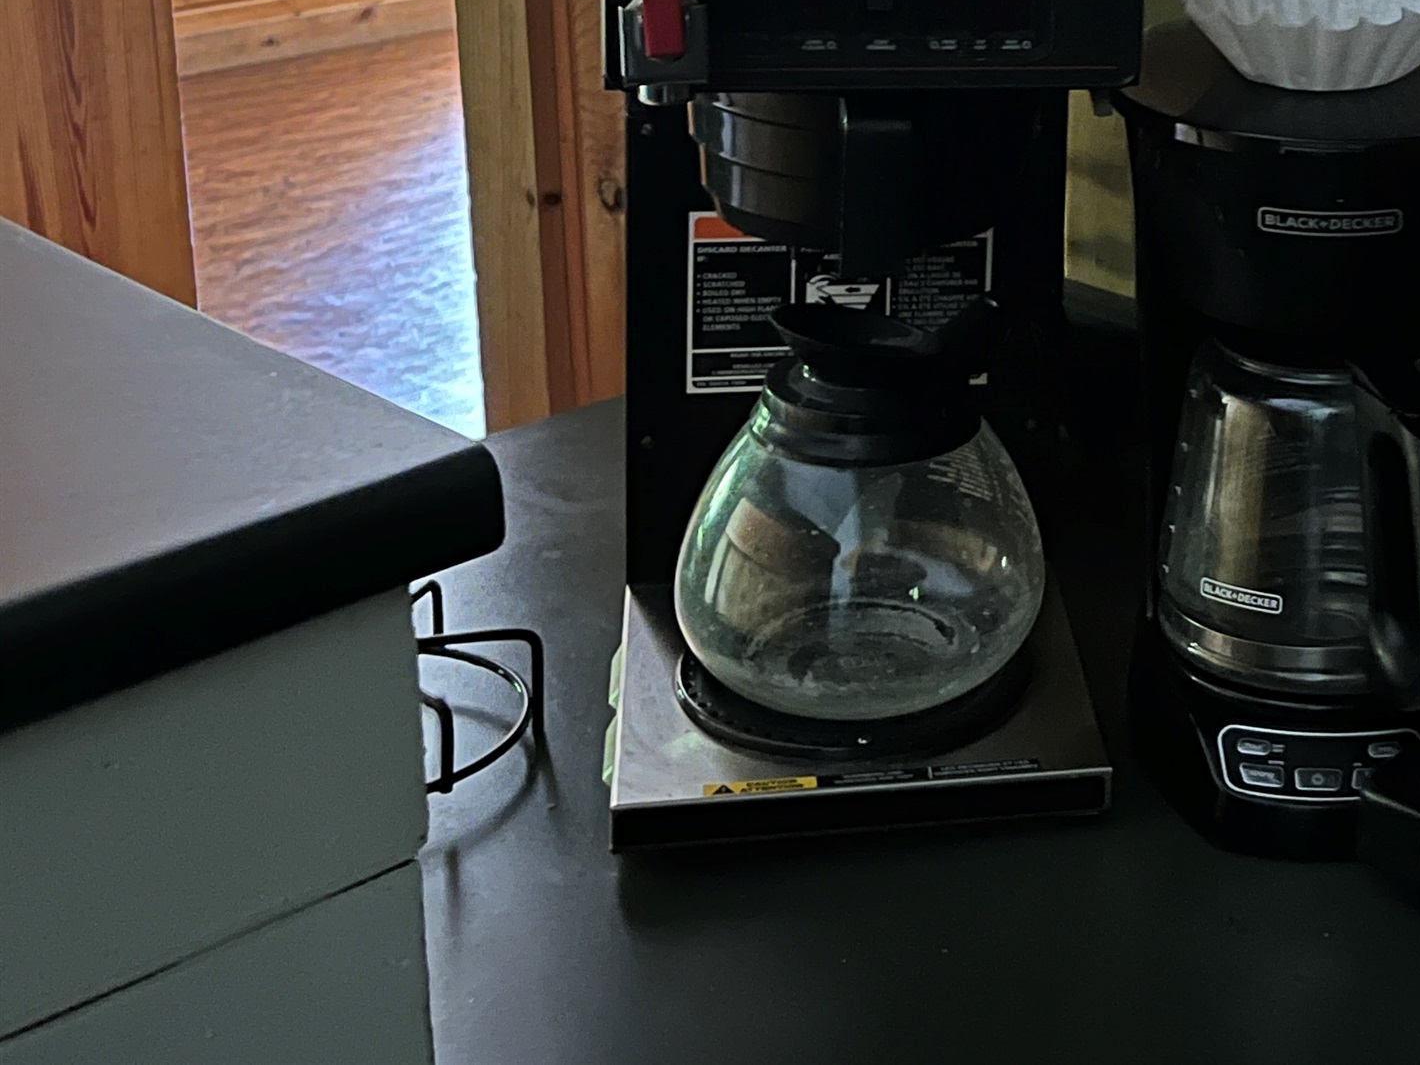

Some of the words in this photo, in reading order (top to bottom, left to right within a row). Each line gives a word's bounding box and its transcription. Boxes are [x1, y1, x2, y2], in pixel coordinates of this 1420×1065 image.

[1263, 213, 1396, 231] BLACK+DECKER
[1202, 582, 1279, 610] BLACK+DECKER
[740, 783, 804, 792] ATTENTION
[746, 779, 798, 787] CAUTION
